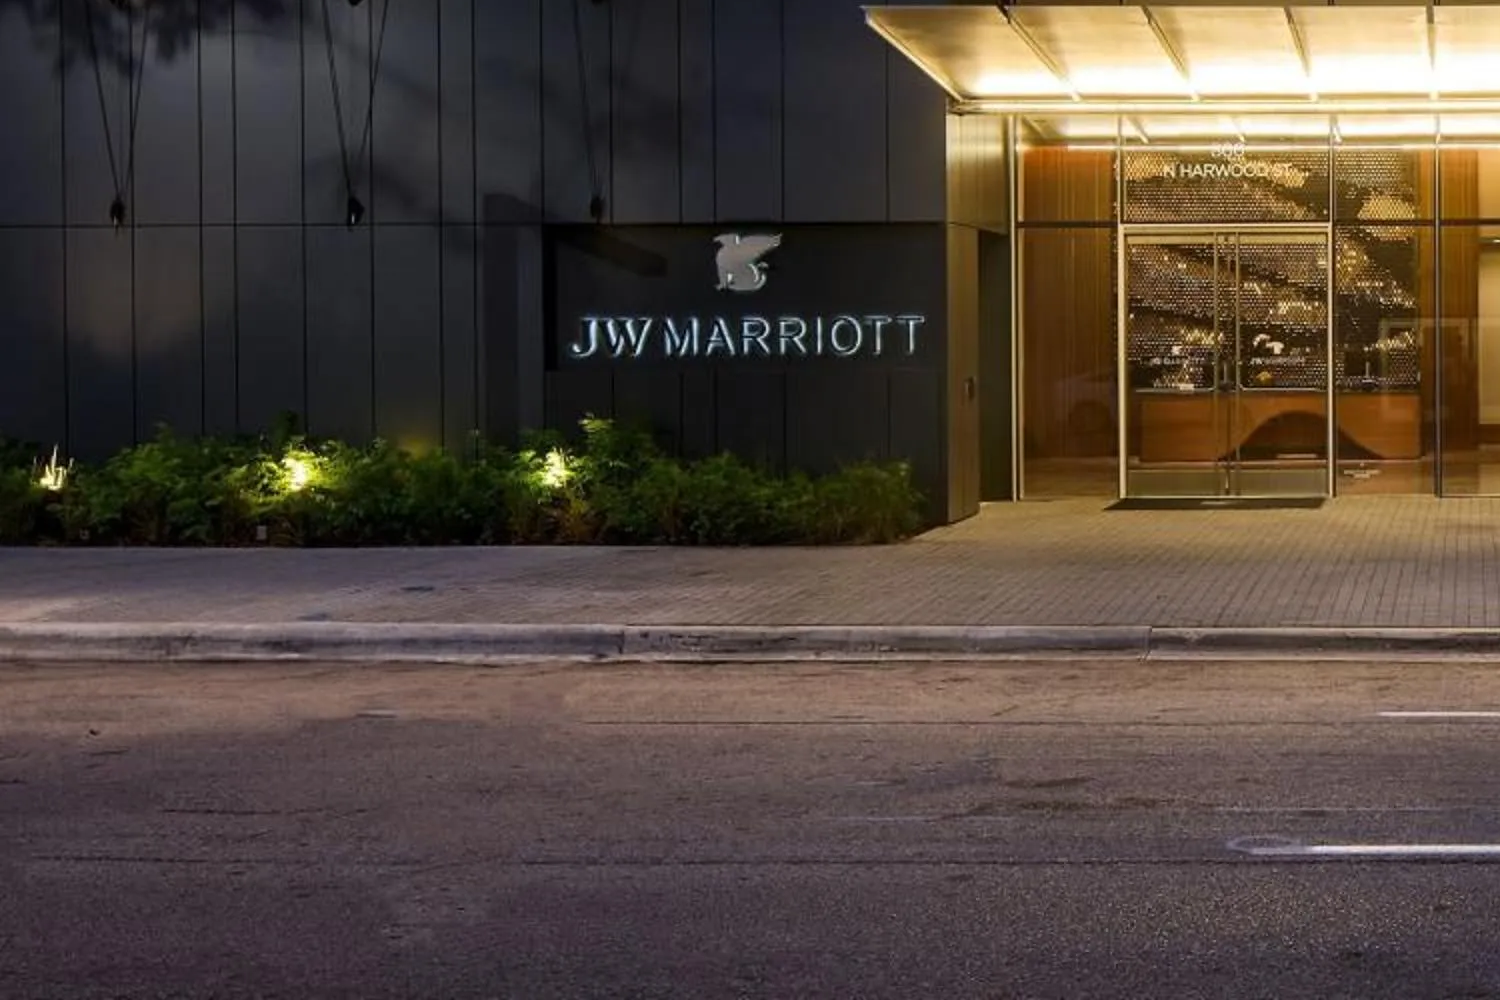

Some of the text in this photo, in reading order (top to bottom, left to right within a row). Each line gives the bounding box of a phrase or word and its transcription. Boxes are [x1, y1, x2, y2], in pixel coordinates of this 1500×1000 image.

[1162, 164, 1176, 178] N
[1180, 164, 1268, 178] HARWOOD
[571, 315, 925, 359] JW MARRIOTT
